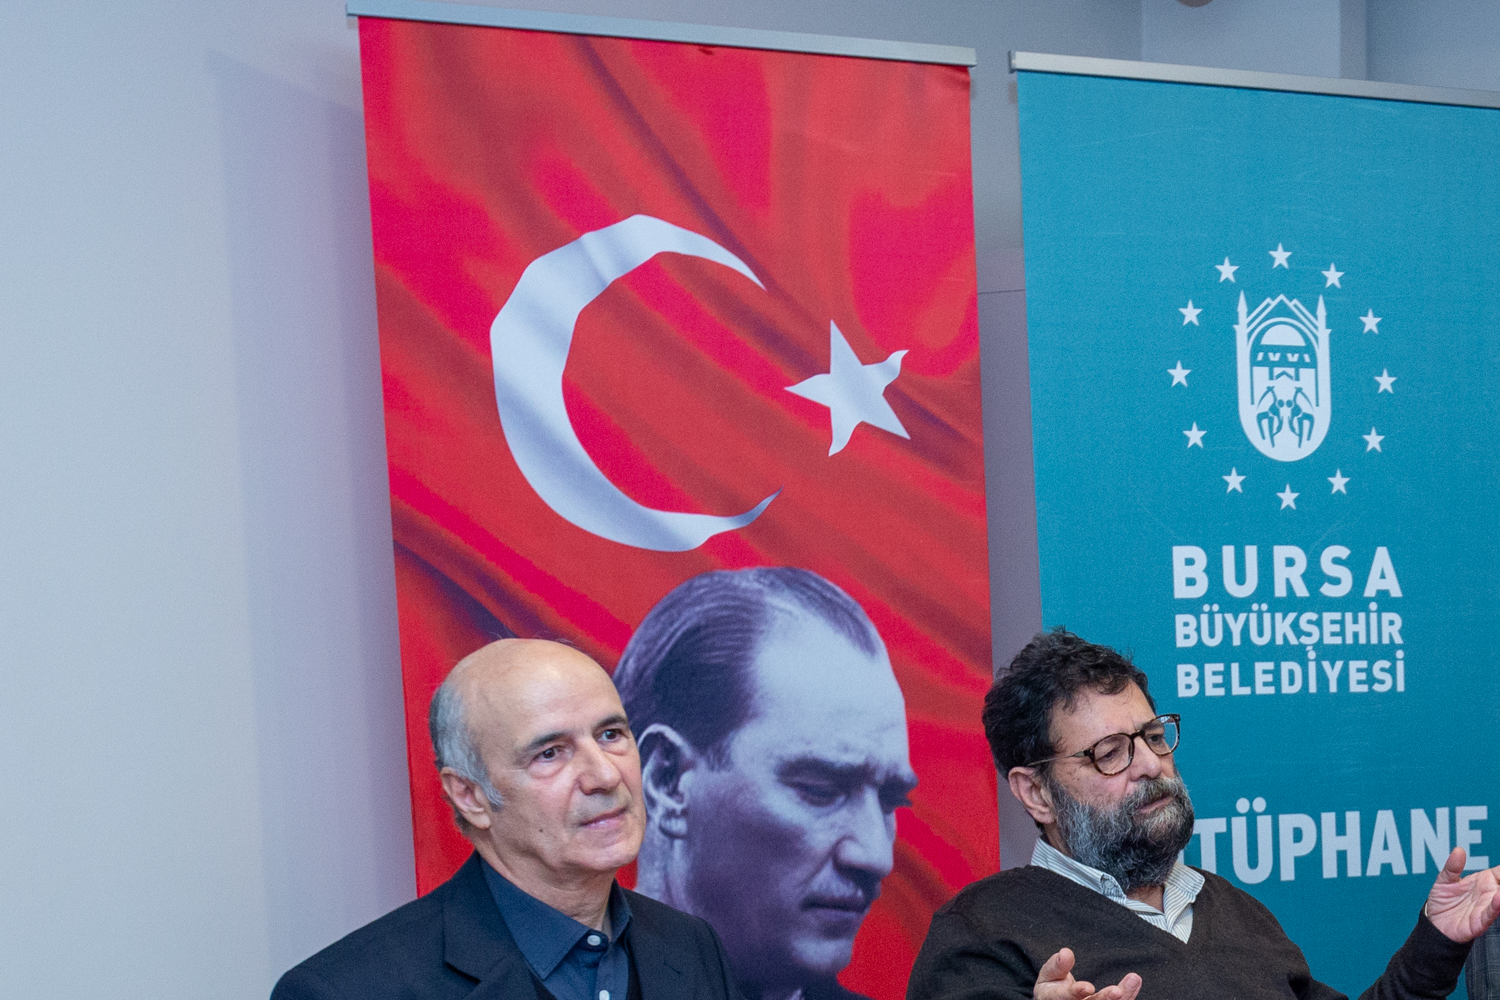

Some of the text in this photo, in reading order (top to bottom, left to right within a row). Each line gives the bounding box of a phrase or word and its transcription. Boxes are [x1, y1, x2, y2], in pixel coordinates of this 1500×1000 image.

[1172, 545, 1403, 599] BURSA
[1175, 601, 1404, 651] BÜYÜKŞEHİR
[1177, 649, 1405, 698] BELEDİYESİ
[1180, 797, 1490, 884] TÜPHANE
